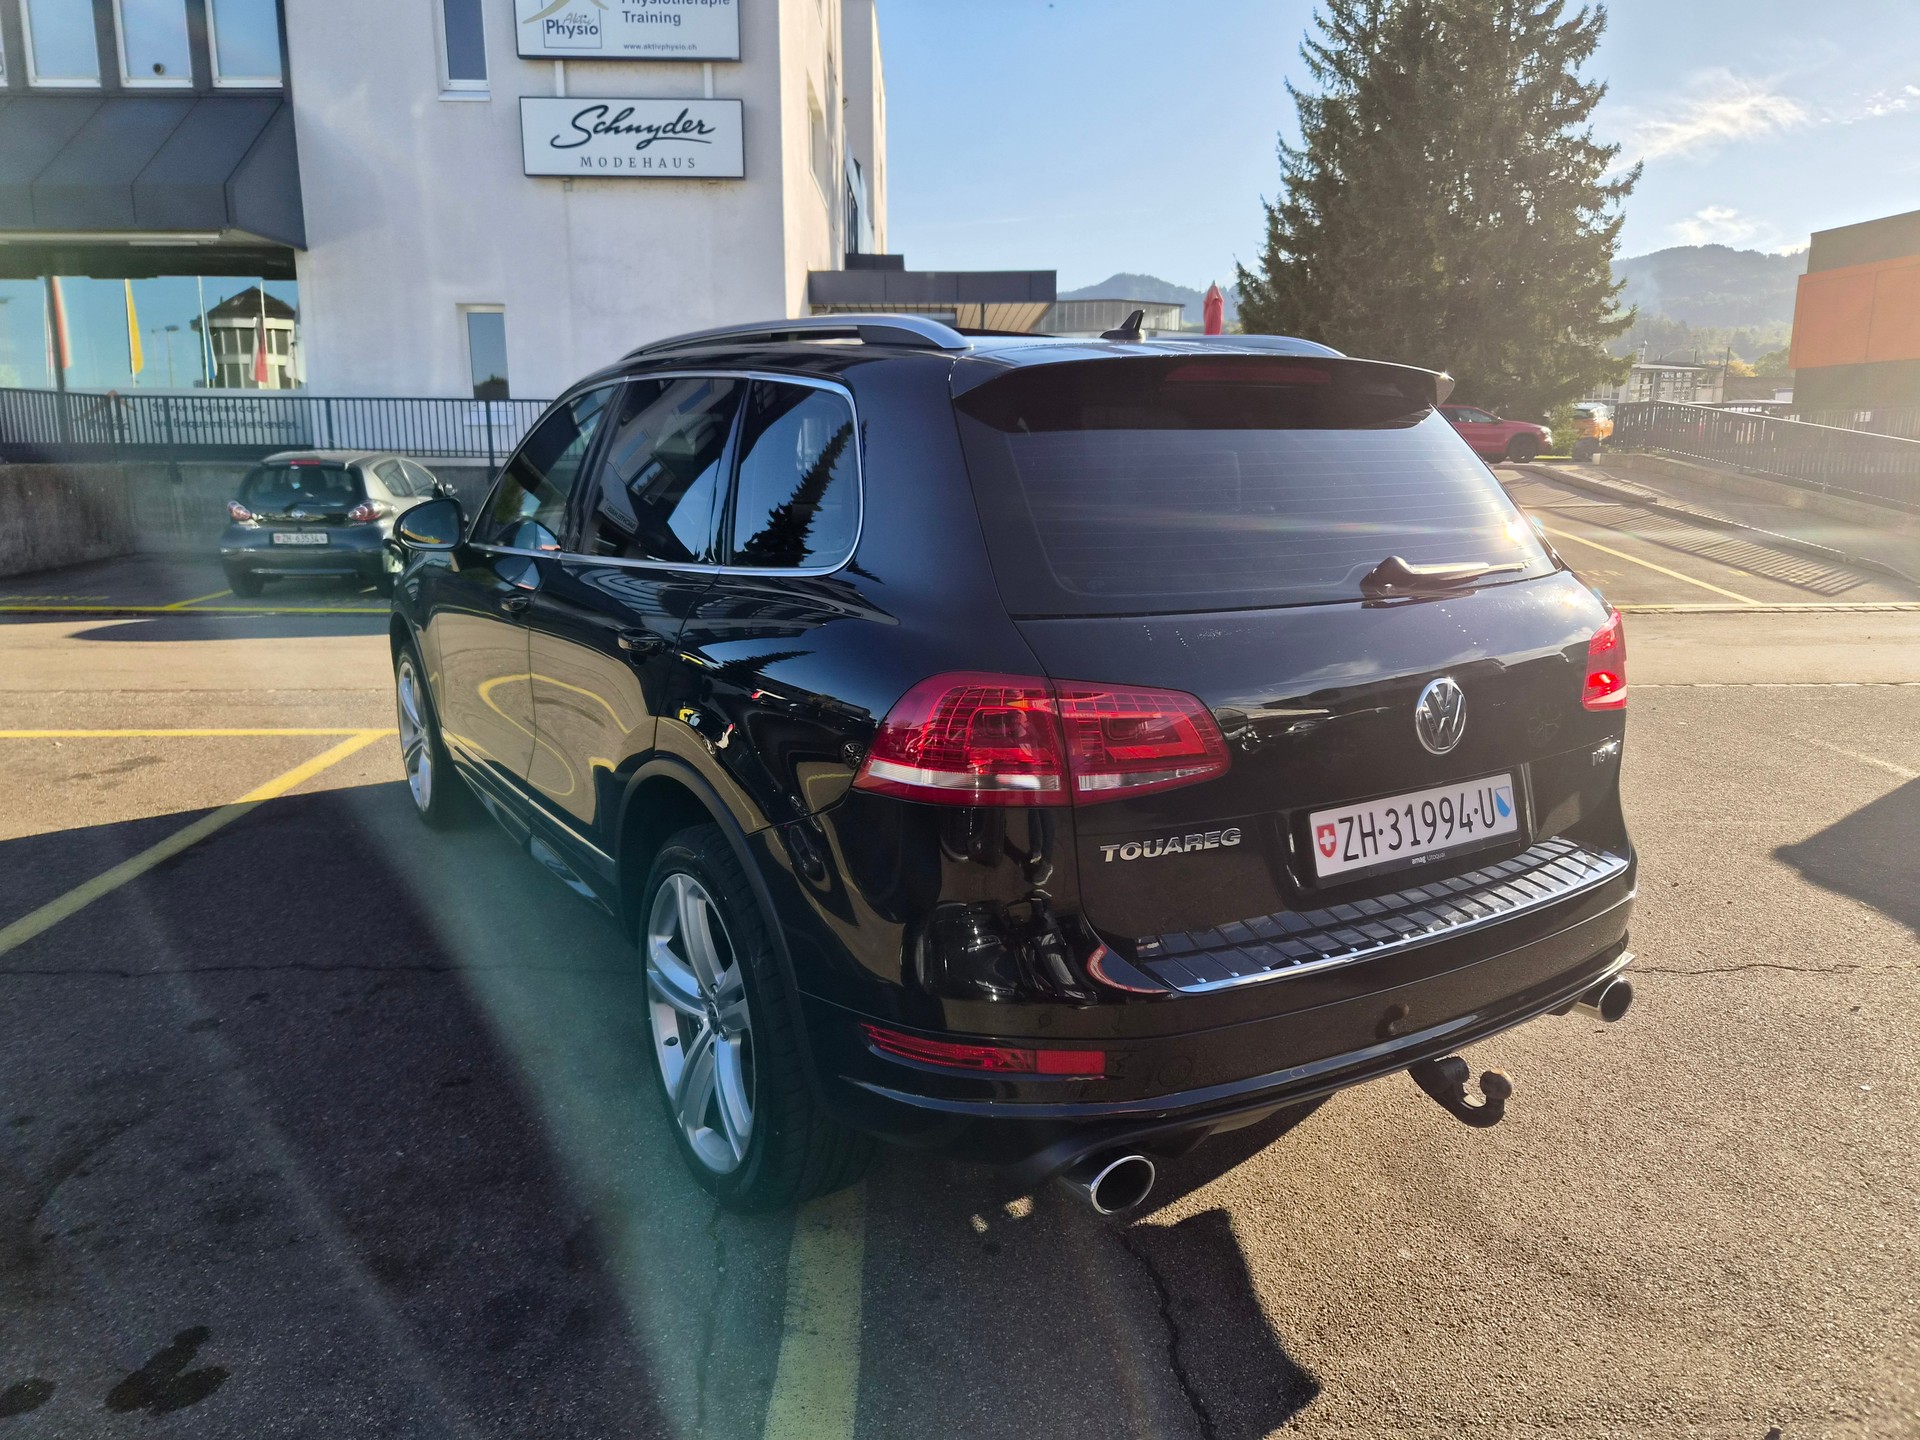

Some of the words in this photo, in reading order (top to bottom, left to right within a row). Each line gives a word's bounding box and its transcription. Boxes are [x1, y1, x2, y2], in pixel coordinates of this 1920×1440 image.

[562, 12, 595, 26] Aktiv
[621, 10, 681, 26] Training
[546, 19, 599, 39] Physio
[623, 42, 698, 52] www.aktivphysio.ch
[550, 104, 716, 150] Schnyder
[580, 156, 697, 169] MODEHAUS
[152, 402, 187, 412] Strke
[1099, 827, 1241, 863] TOUAREG
